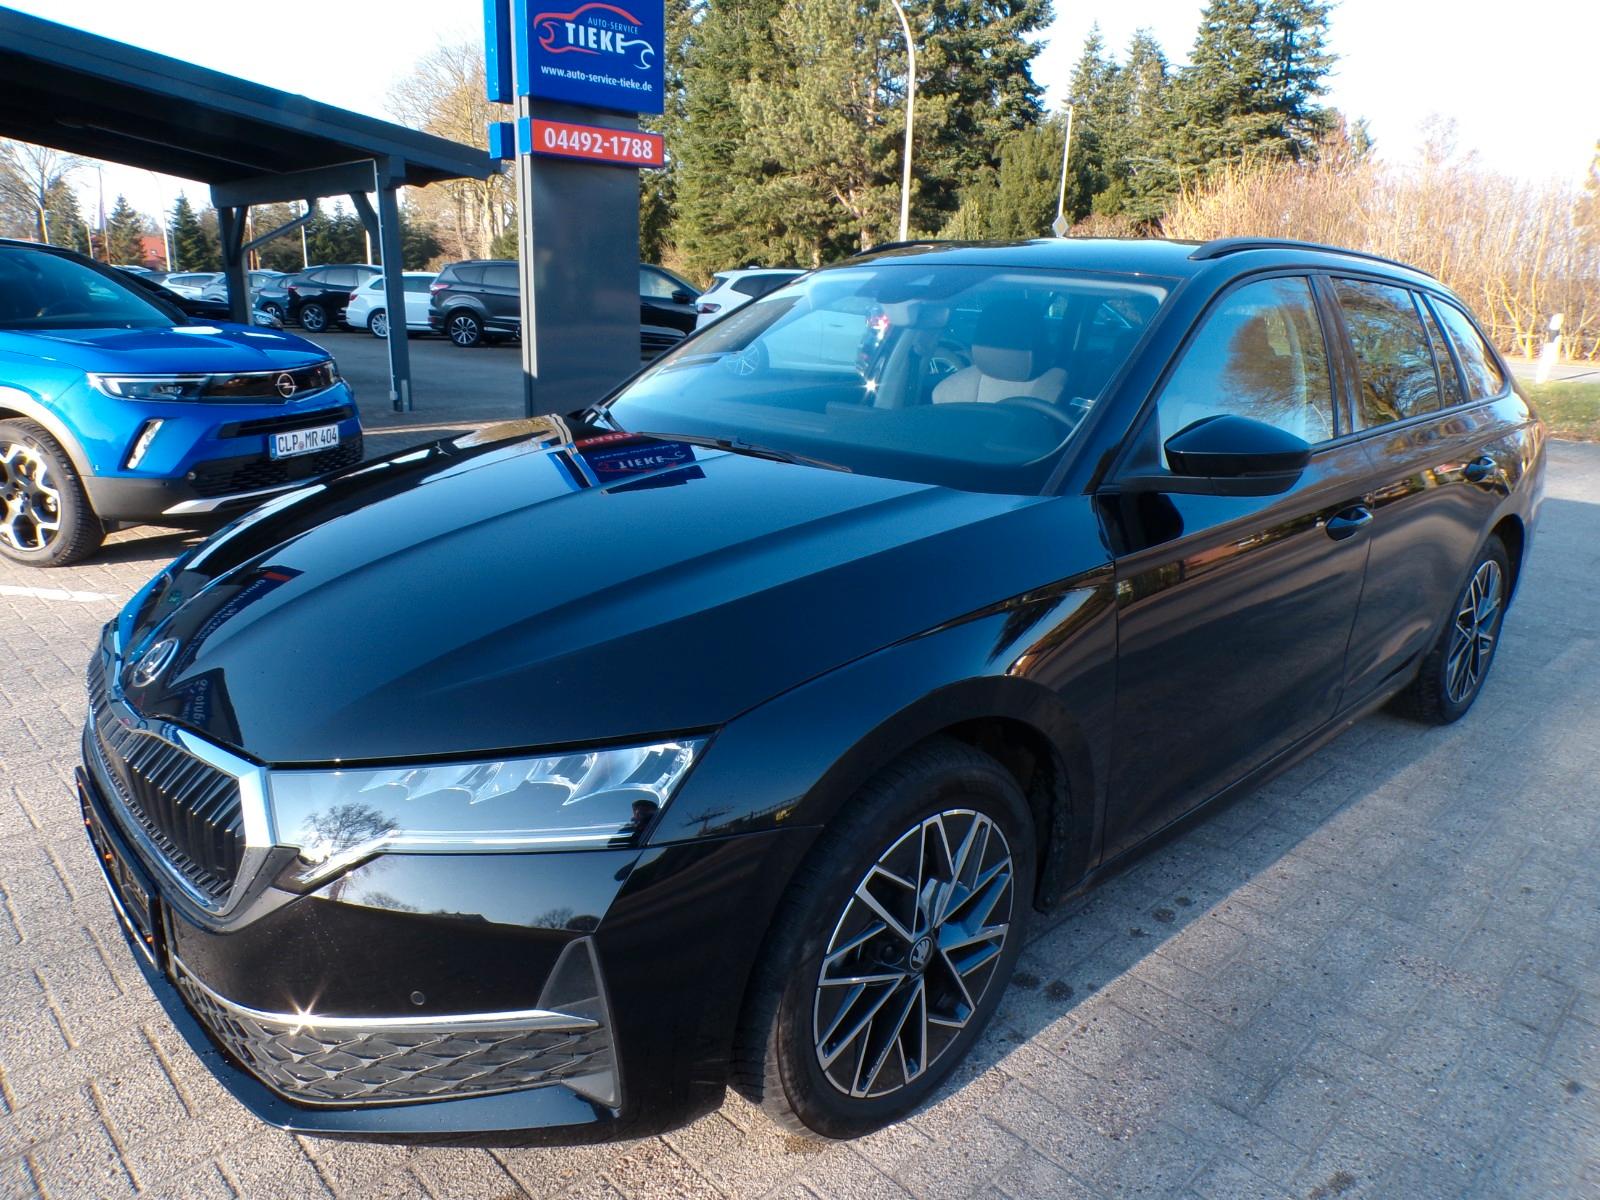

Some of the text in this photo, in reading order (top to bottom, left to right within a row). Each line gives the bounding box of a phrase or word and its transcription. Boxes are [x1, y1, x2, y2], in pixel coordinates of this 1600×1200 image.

[565, 22, 626, 54] TIEKE
[587, 16, 639, 35] AUTO-SERVICE
[540, 65, 653, 92] www.auto-service-tieke.de
[544, 127, 653, 159] 04492-1788
[278, 427, 337, 453] CLP MR 404
